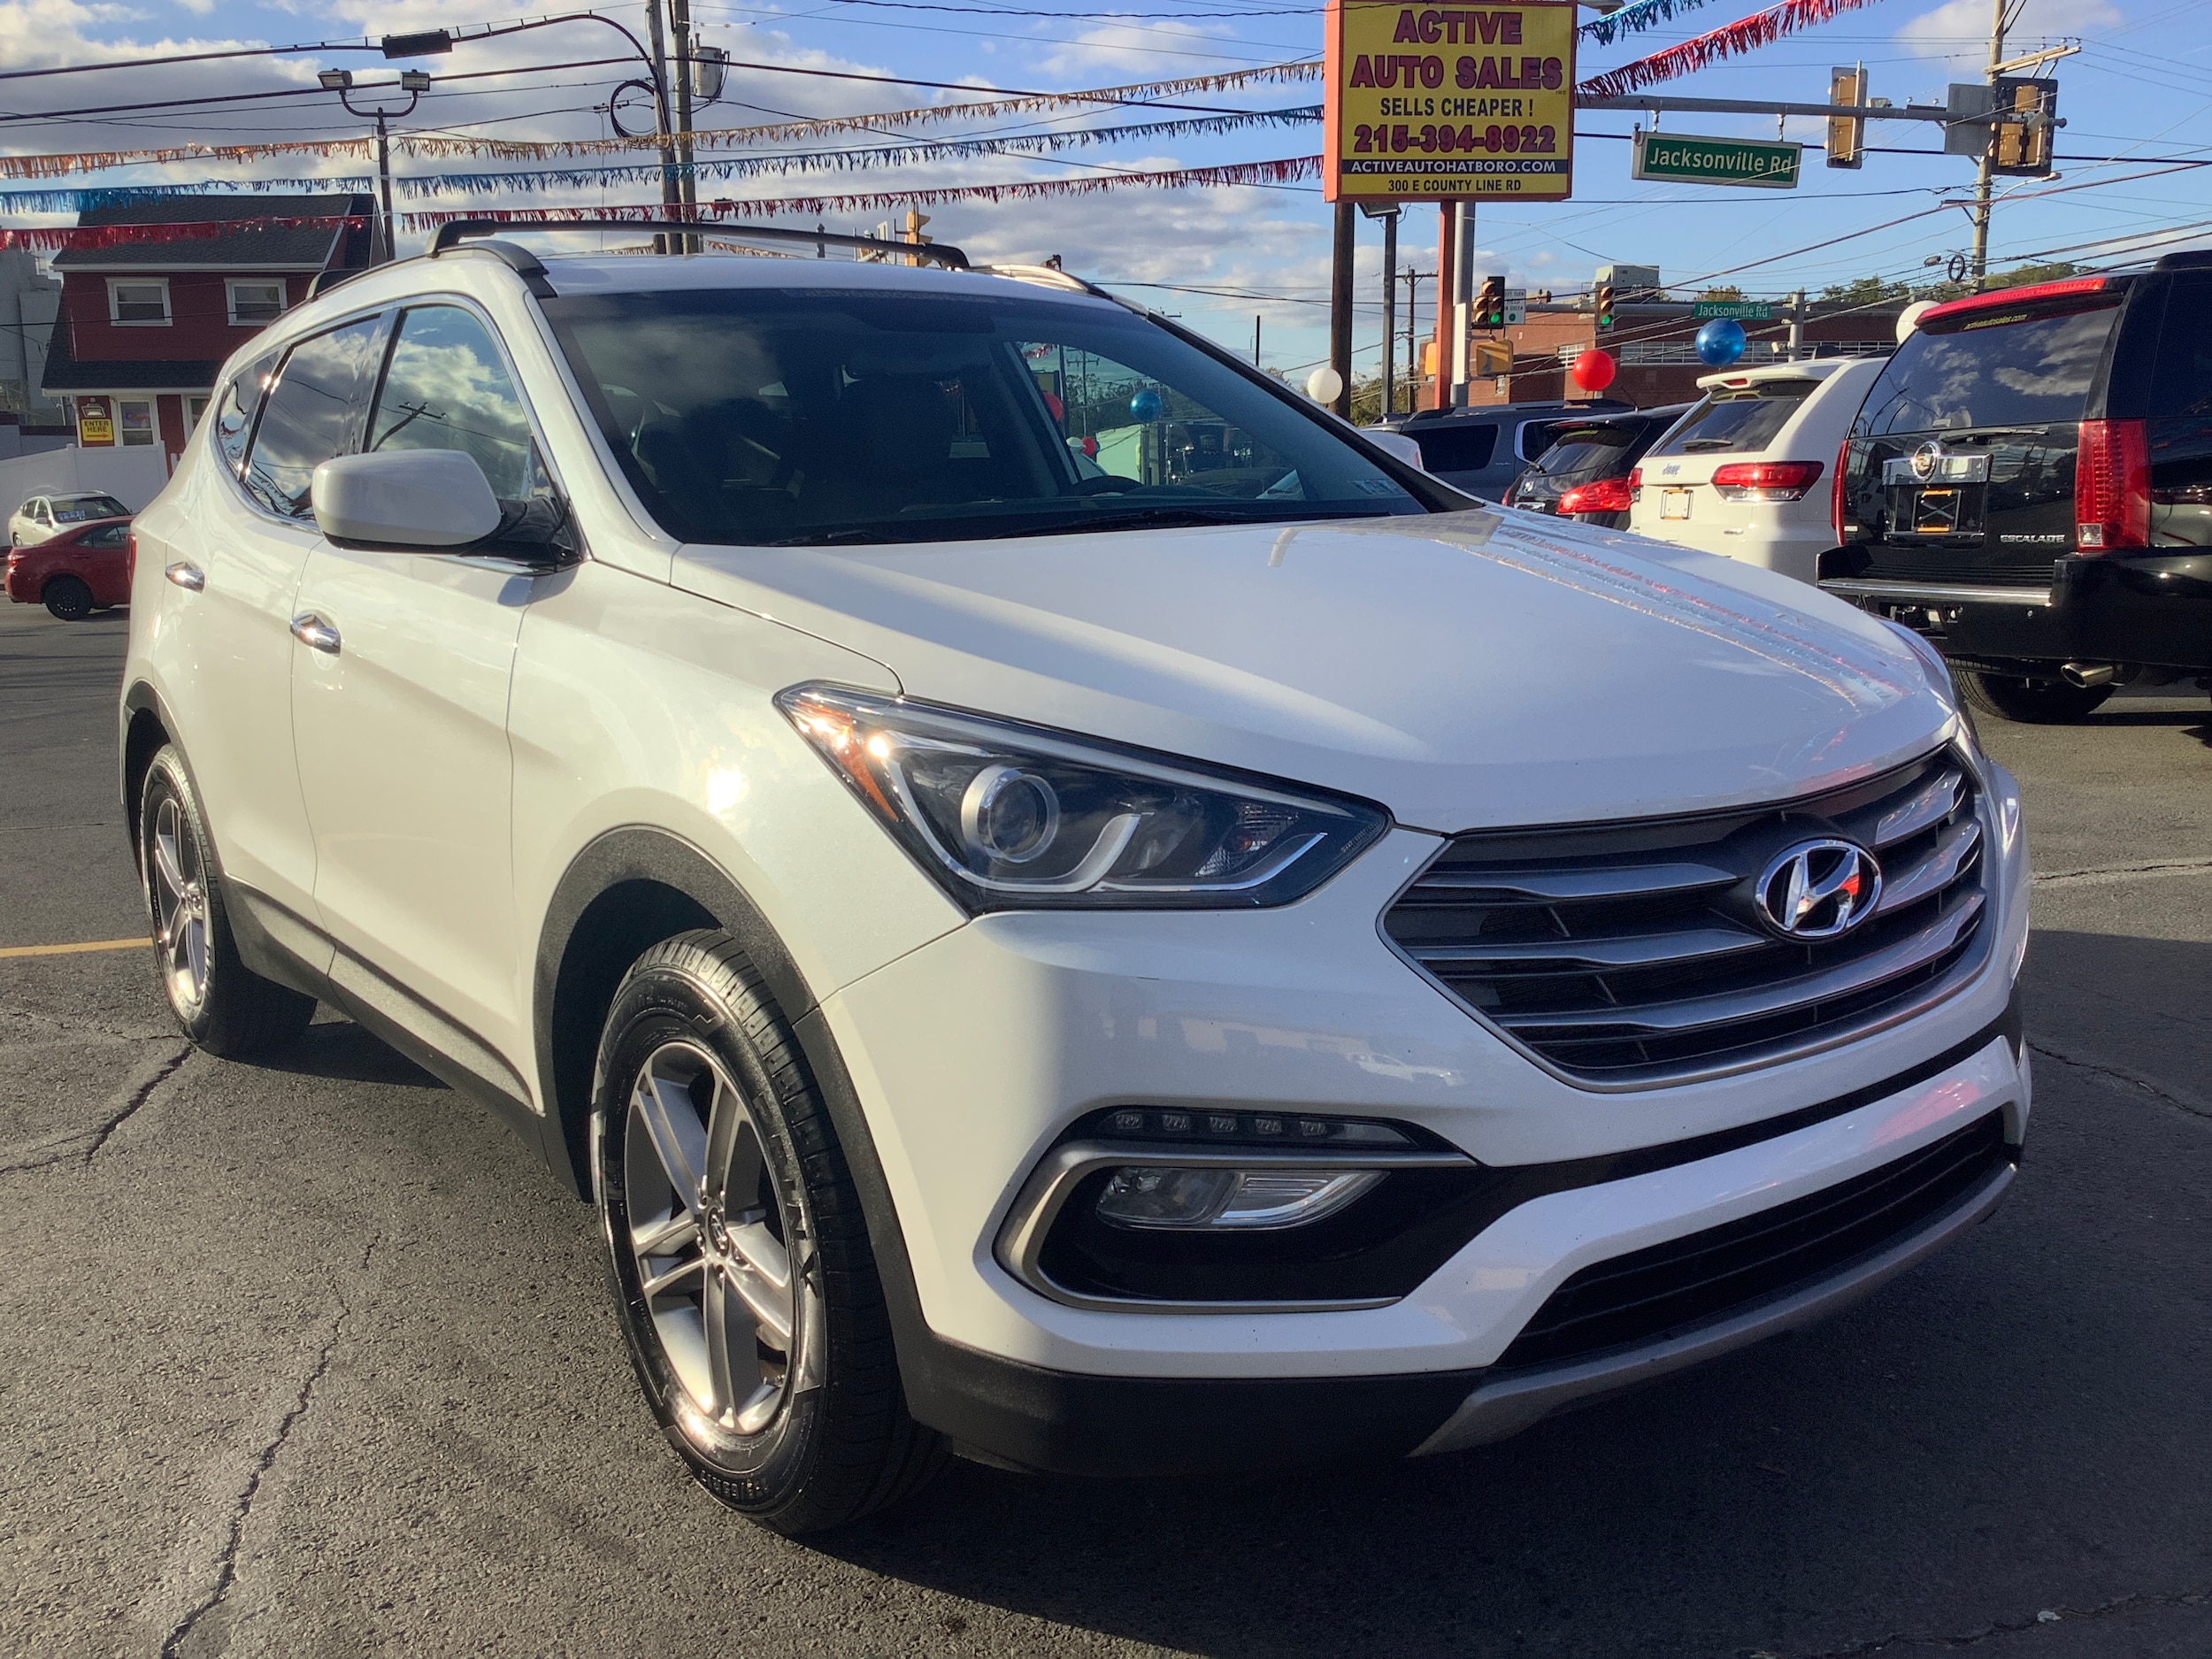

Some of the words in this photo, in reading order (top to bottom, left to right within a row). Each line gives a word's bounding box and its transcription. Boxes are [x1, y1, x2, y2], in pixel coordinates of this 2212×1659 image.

[1393, 10, 1523, 44] ACTIVE
[1349, 54, 1444, 88] AUTO
[1455, 56, 1563, 90] SALES
[1380, 97, 1434, 117] SELLS
[1440, 98, 1523, 117] CHEAPER
[1354, 124, 1555, 153] 215-394-8922
[1351, 160, 1556, 173] ACTIVEAUTOHATBORO.COM
[1650, 147, 1764, 173] Jacksonville
[1770, 155, 1793, 174] Rd
[1388, 180, 1409, 192] 300
[1412, 180, 1419, 191] E
[1423, 180, 1471, 192] COUNTY
[1476, 180, 1502, 191] LINE
[1506, 180, 1521, 191] RD
[1699, 304, 1754, 318] Jacksonville
[1755, 305, 1768, 318] Rd
[2000, 534, 2066, 543] ESCALADE
